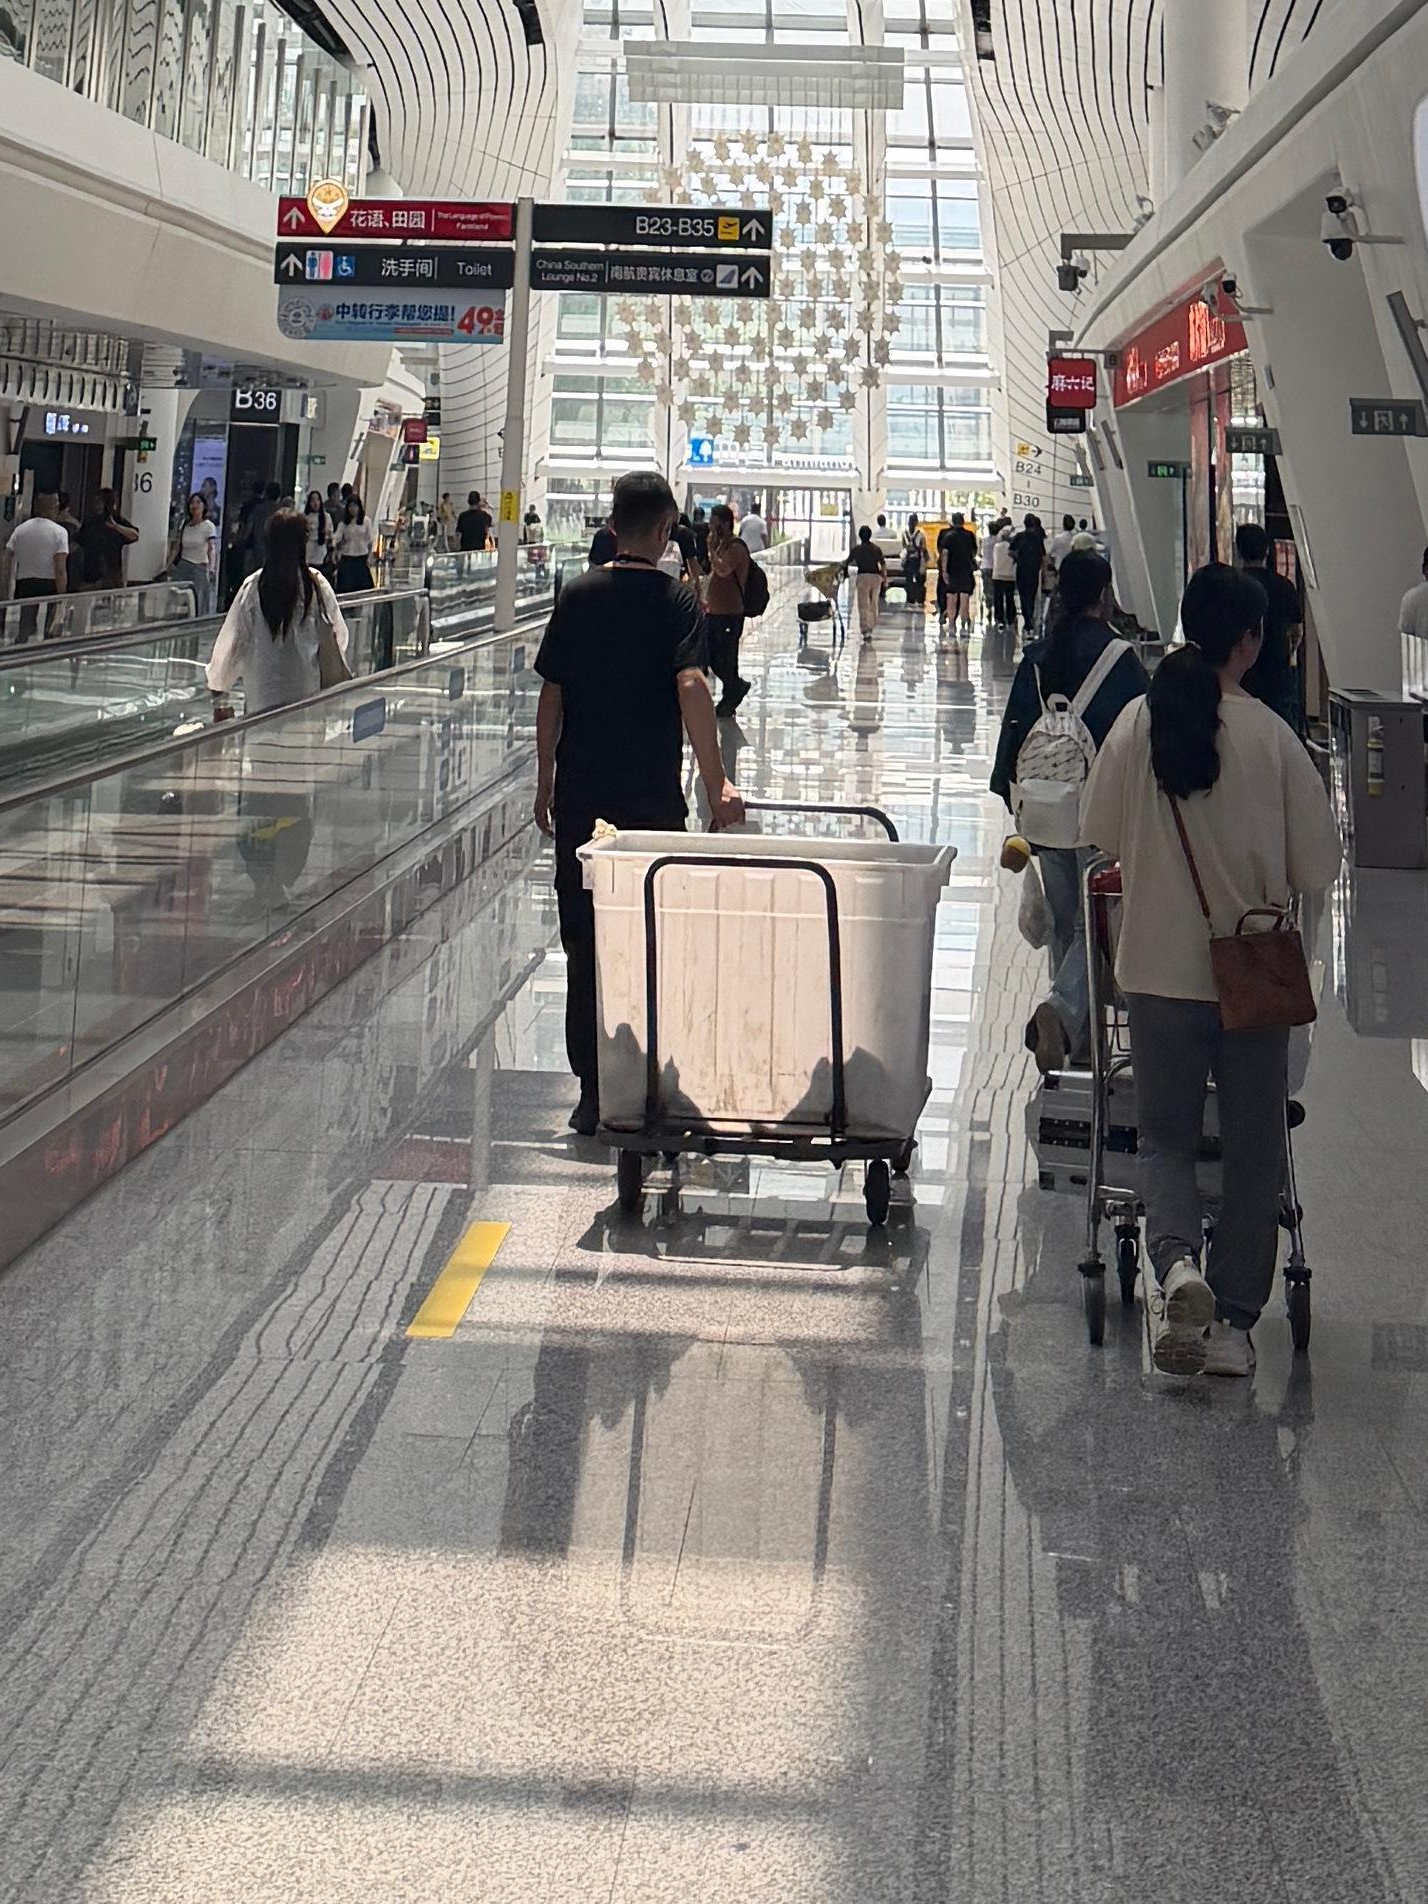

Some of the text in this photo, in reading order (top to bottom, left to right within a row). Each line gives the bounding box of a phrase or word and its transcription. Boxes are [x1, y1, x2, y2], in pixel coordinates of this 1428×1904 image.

[349, 210, 426, 229] 花语、田园
[635, 216, 715, 237] B23-B35
[381, 258, 433, 278] 洗手间
[456, 262, 492, 276] Toilet
[536, 260, 604, 272] China Southern
[541, 272, 598, 284] Lounge No.2
[1050, 374, 1096, 393] 麻六记
[1015, 461, 1042, 476] B24
[1013, 493, 1040, 508] B30
